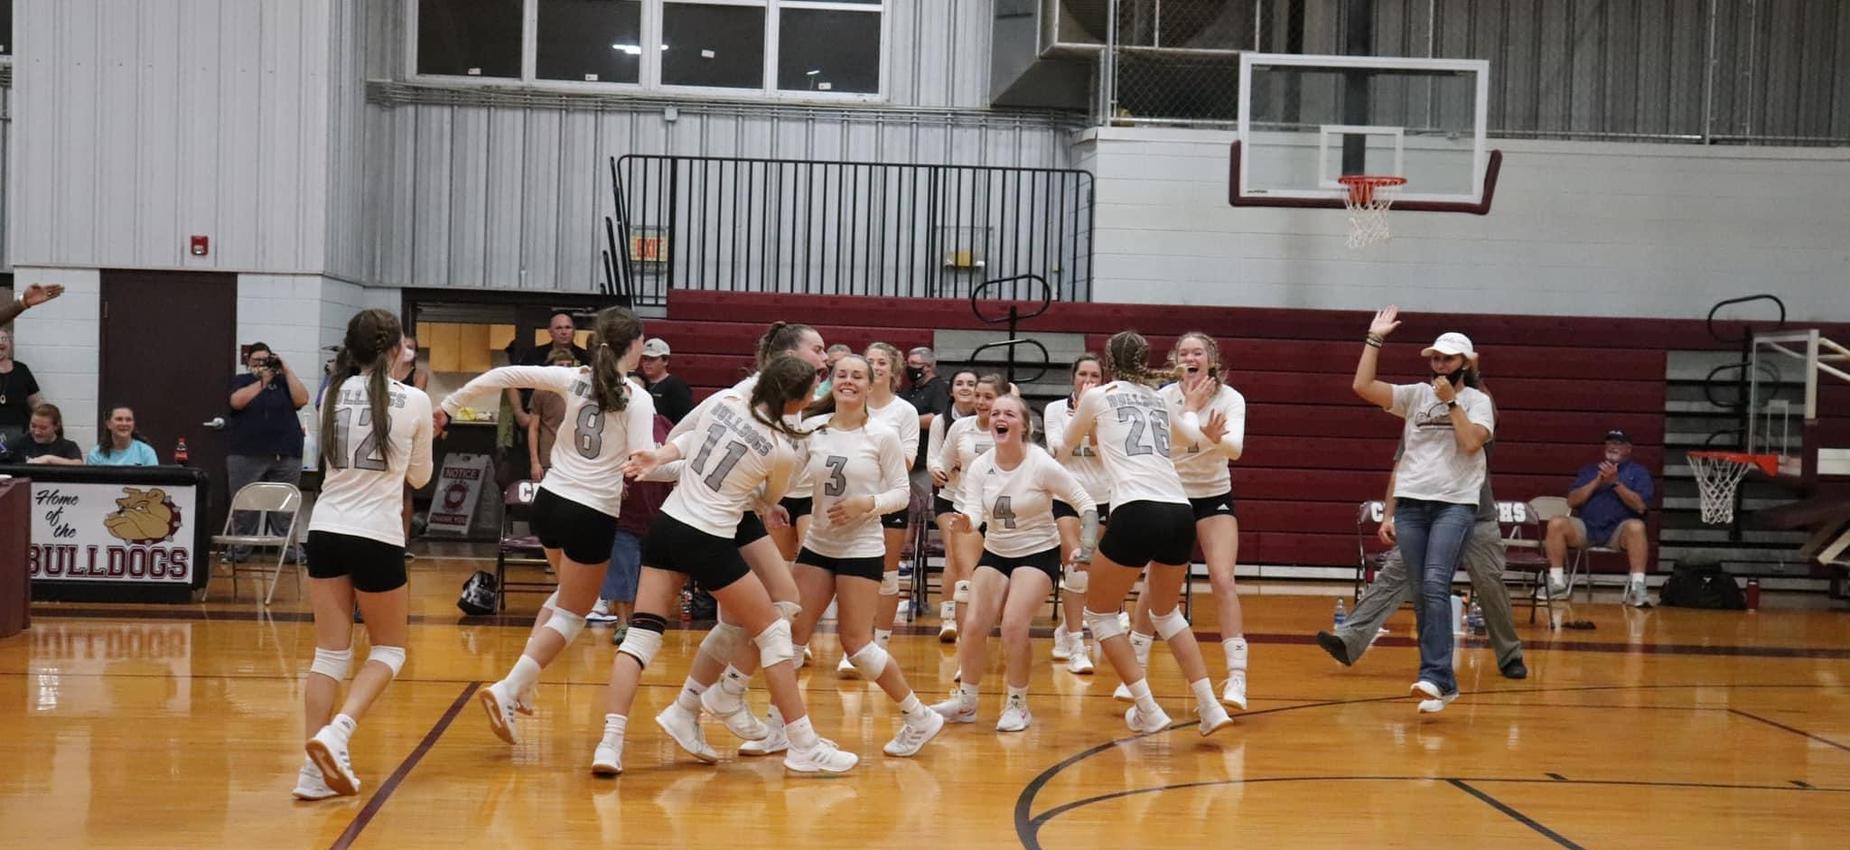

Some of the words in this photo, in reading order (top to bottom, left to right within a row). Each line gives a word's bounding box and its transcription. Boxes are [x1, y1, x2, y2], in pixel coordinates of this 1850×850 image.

[333, 407, 393, 472] 12
[574, 403, 606, 460] 8
[1116, 406, 1170, 458] 26
[446, 468, 477, 478] NOTICE
[690, 423, 749, 493] 11
[824, 455, 849, 497] 3
[36, 489, 79, 505] Home
[993, 495, 1017, 529] 4
[1495, 501, 1527, 522] HS
[45, 507, 62, 526] of
[54, 523, 77, 538] the
[31, 544, 189, 580] BULLDOGS
